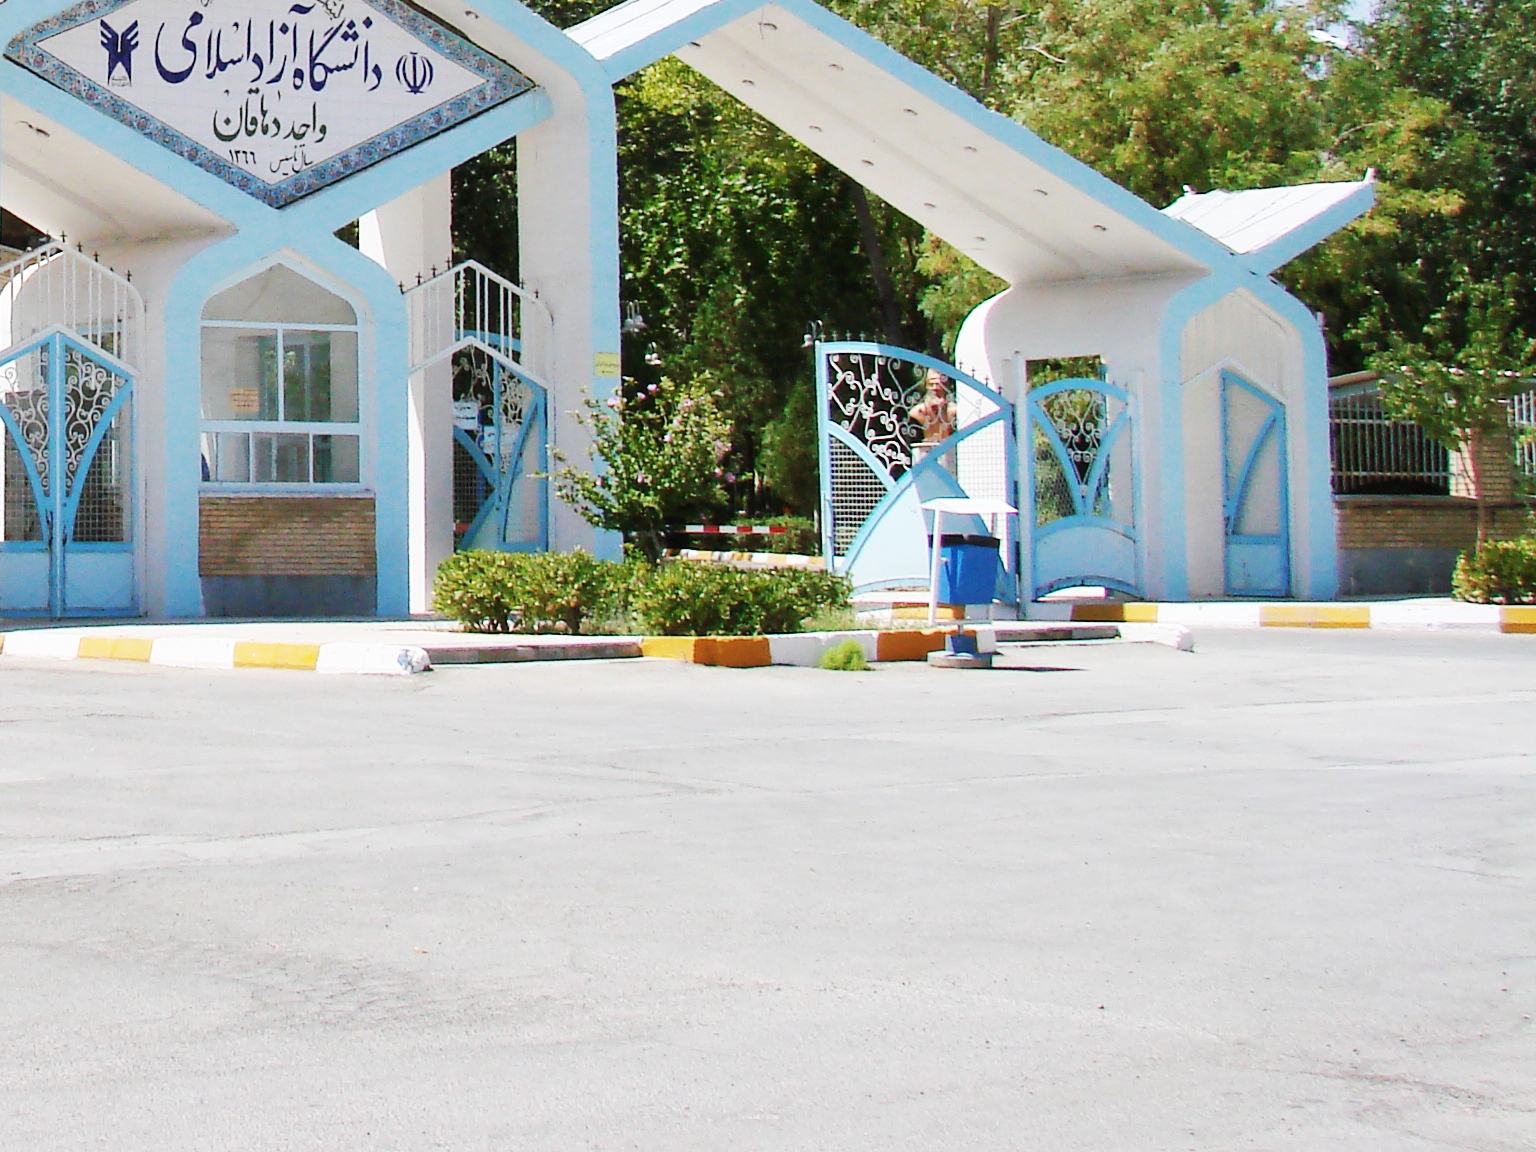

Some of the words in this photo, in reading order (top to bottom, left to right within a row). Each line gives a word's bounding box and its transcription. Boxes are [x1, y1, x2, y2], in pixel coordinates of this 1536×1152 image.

[154, 10, 252, 84] اسلامی
[249, 3, 315, 85] آزاد
[292, 16, 383, 92] دانشگاه
[213, 87, 281, 143] دهاقان
[283, 100, 327, 144] واحد
[291, 149, 314, 175] سال
